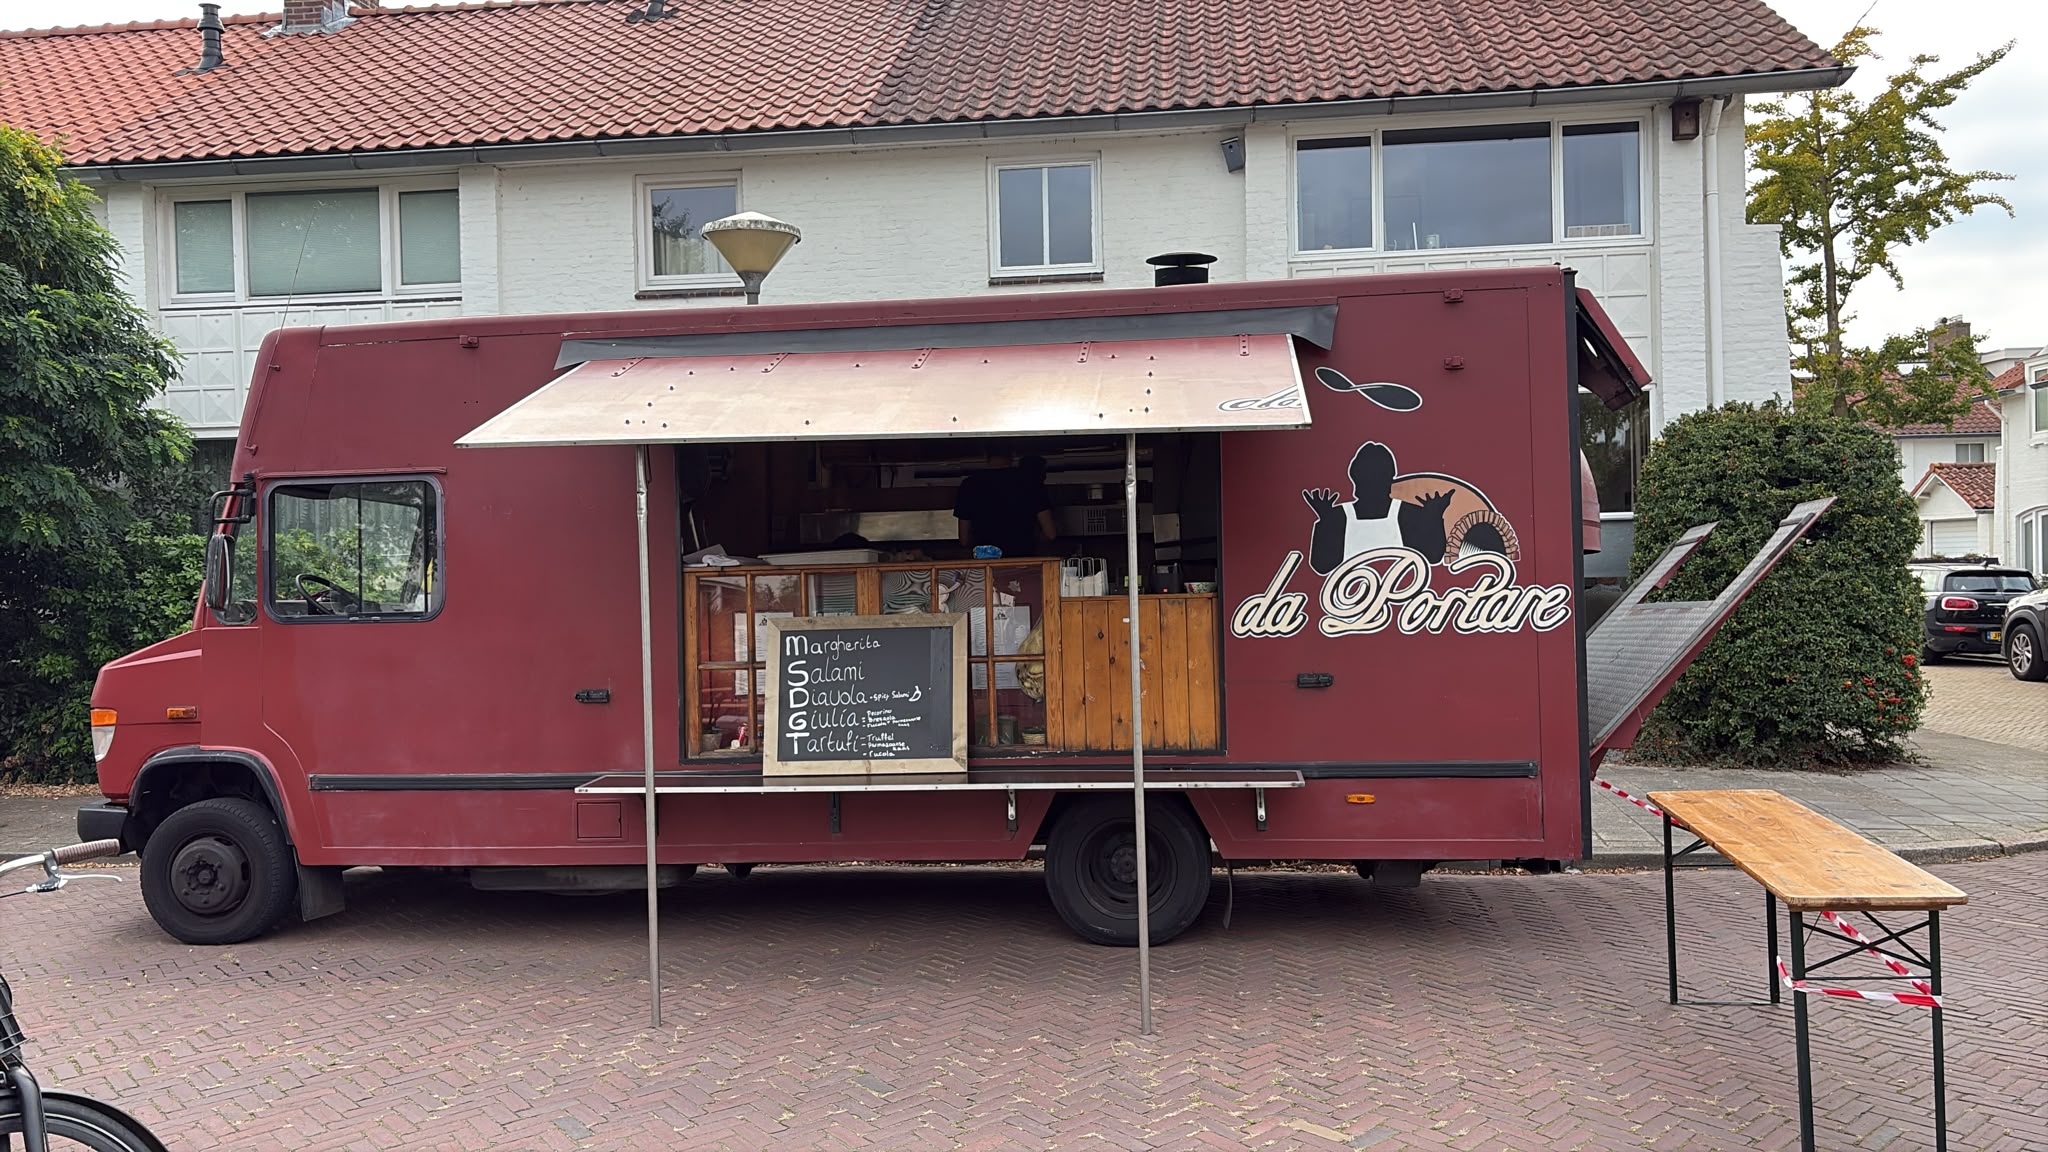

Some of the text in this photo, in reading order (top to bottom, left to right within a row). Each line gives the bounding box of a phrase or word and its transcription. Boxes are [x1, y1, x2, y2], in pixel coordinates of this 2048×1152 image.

[1231, 546, 1572, 637] da Portare
[785, 634, 881, 661] Margherita
[787, 656, 865, 687] Salami
[789, 684, 868, 709] Diavola
[788, 708, 860, 731] Giulia
[785, 730, 859, 755] Tartufi
